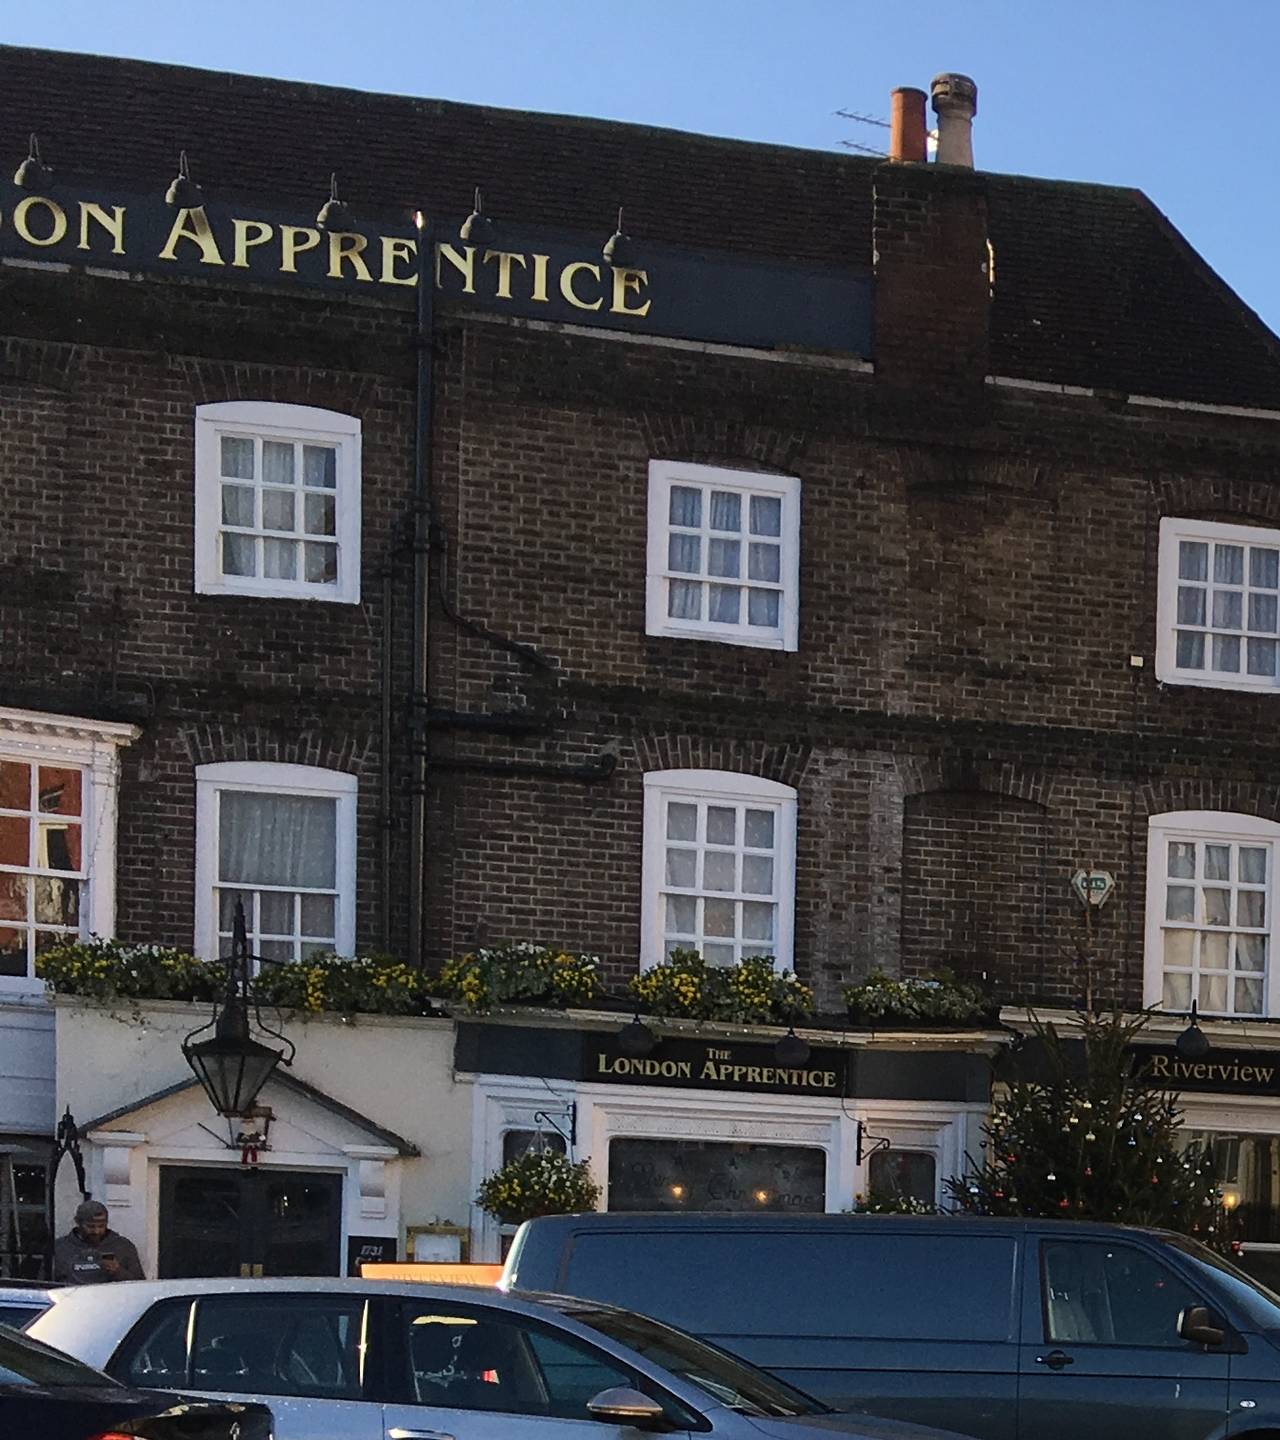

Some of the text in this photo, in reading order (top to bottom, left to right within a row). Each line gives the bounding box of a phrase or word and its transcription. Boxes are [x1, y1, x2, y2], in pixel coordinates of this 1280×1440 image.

[0, 196, 652, 317] ON APPRENTICE
[706, 1047, 732, 1060] THE
[1151, 1054, 1275, 1083] Riverview
[598, 1053, 837, 1089] LONDON APPRENTICE
